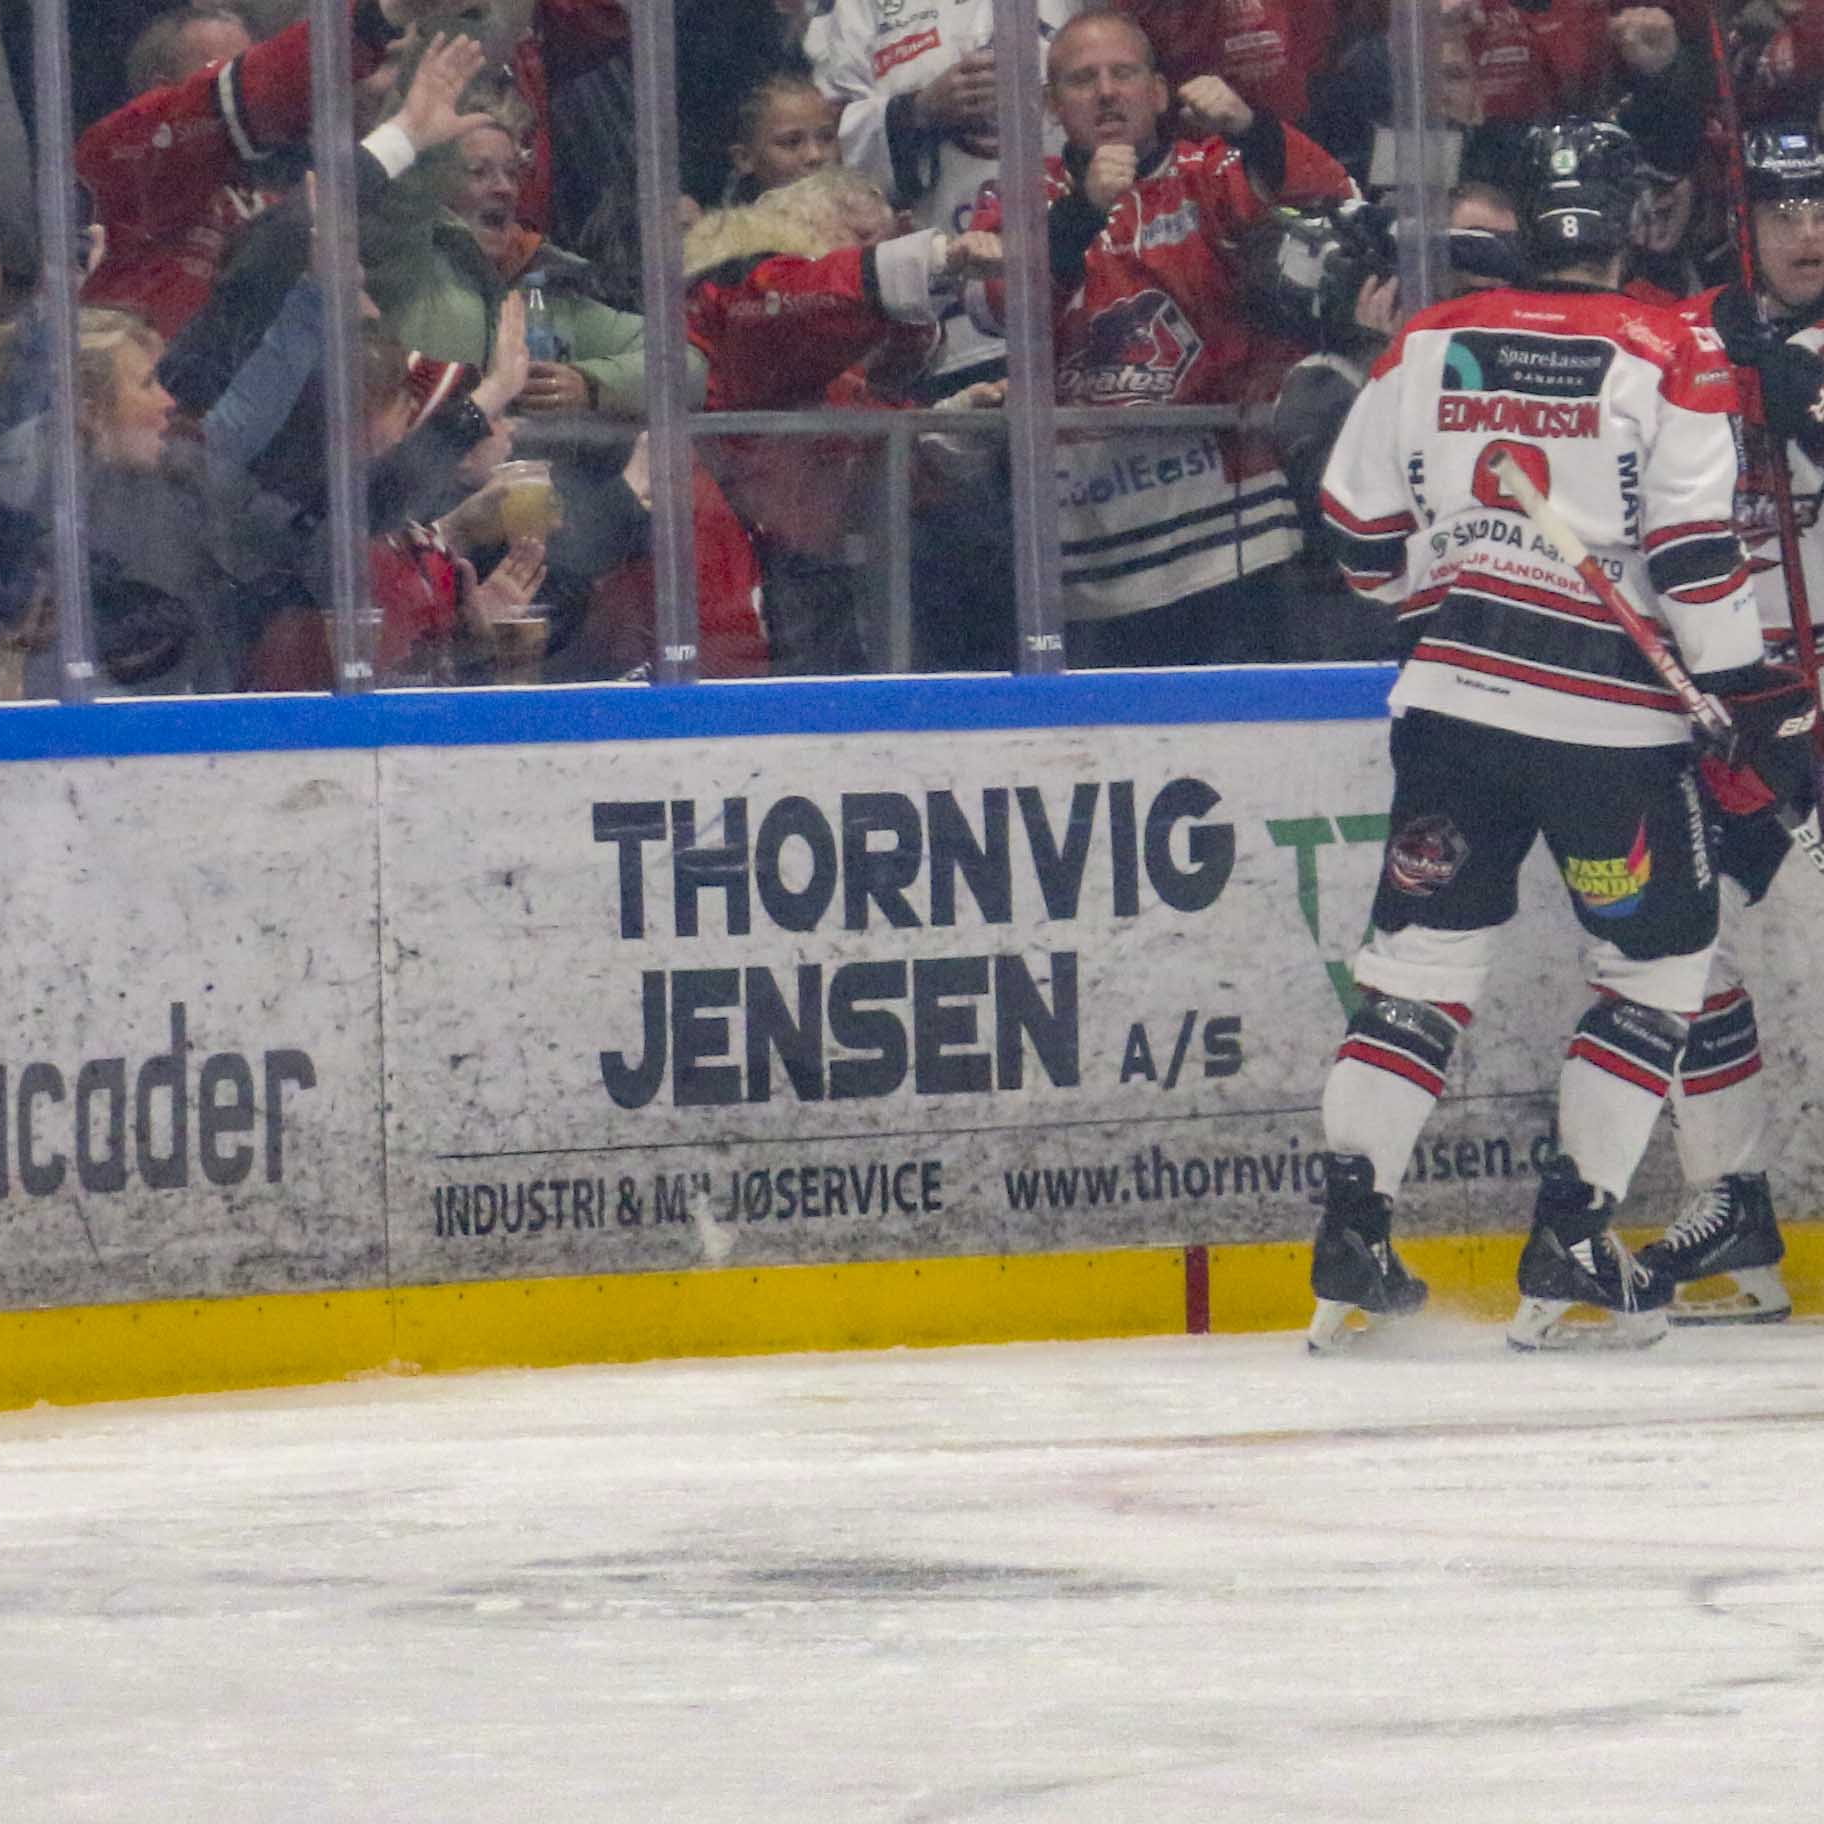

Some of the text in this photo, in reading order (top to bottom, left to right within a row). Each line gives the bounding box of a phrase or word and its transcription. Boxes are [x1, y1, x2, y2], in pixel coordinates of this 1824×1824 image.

[1437, 393, 1602, 440] EDMONDSON
[590, 776, 1237, 940] THORNVIG
[598, 951, 1244, 1112] JENSEN A/S
[432, 1177, 607, 1239] INDUSTRI
[615, 1175, 644, 1229] &
